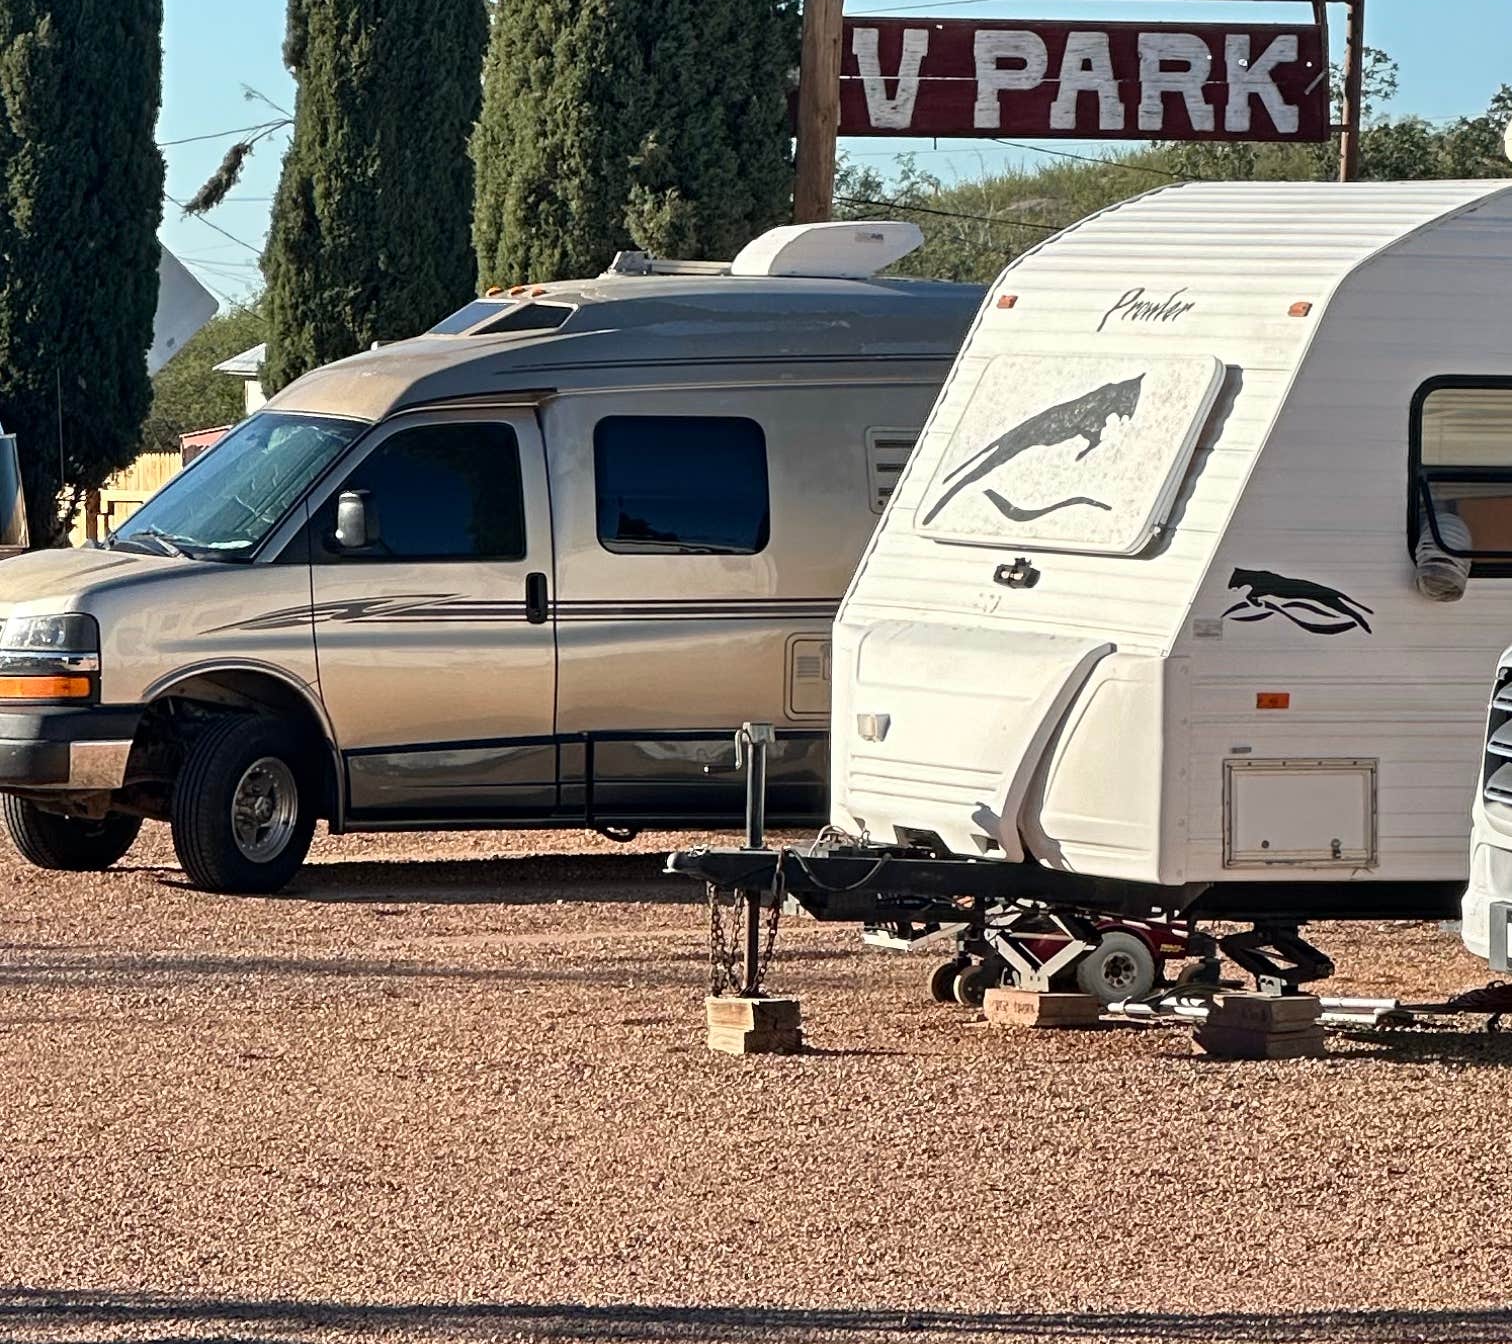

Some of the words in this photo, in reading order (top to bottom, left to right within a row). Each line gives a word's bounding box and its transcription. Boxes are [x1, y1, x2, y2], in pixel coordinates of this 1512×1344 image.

[837, 28, 929, 129] V
[973, 29, 1299, 134] PARK
[1096, 287, 1196, 332] Prowler
